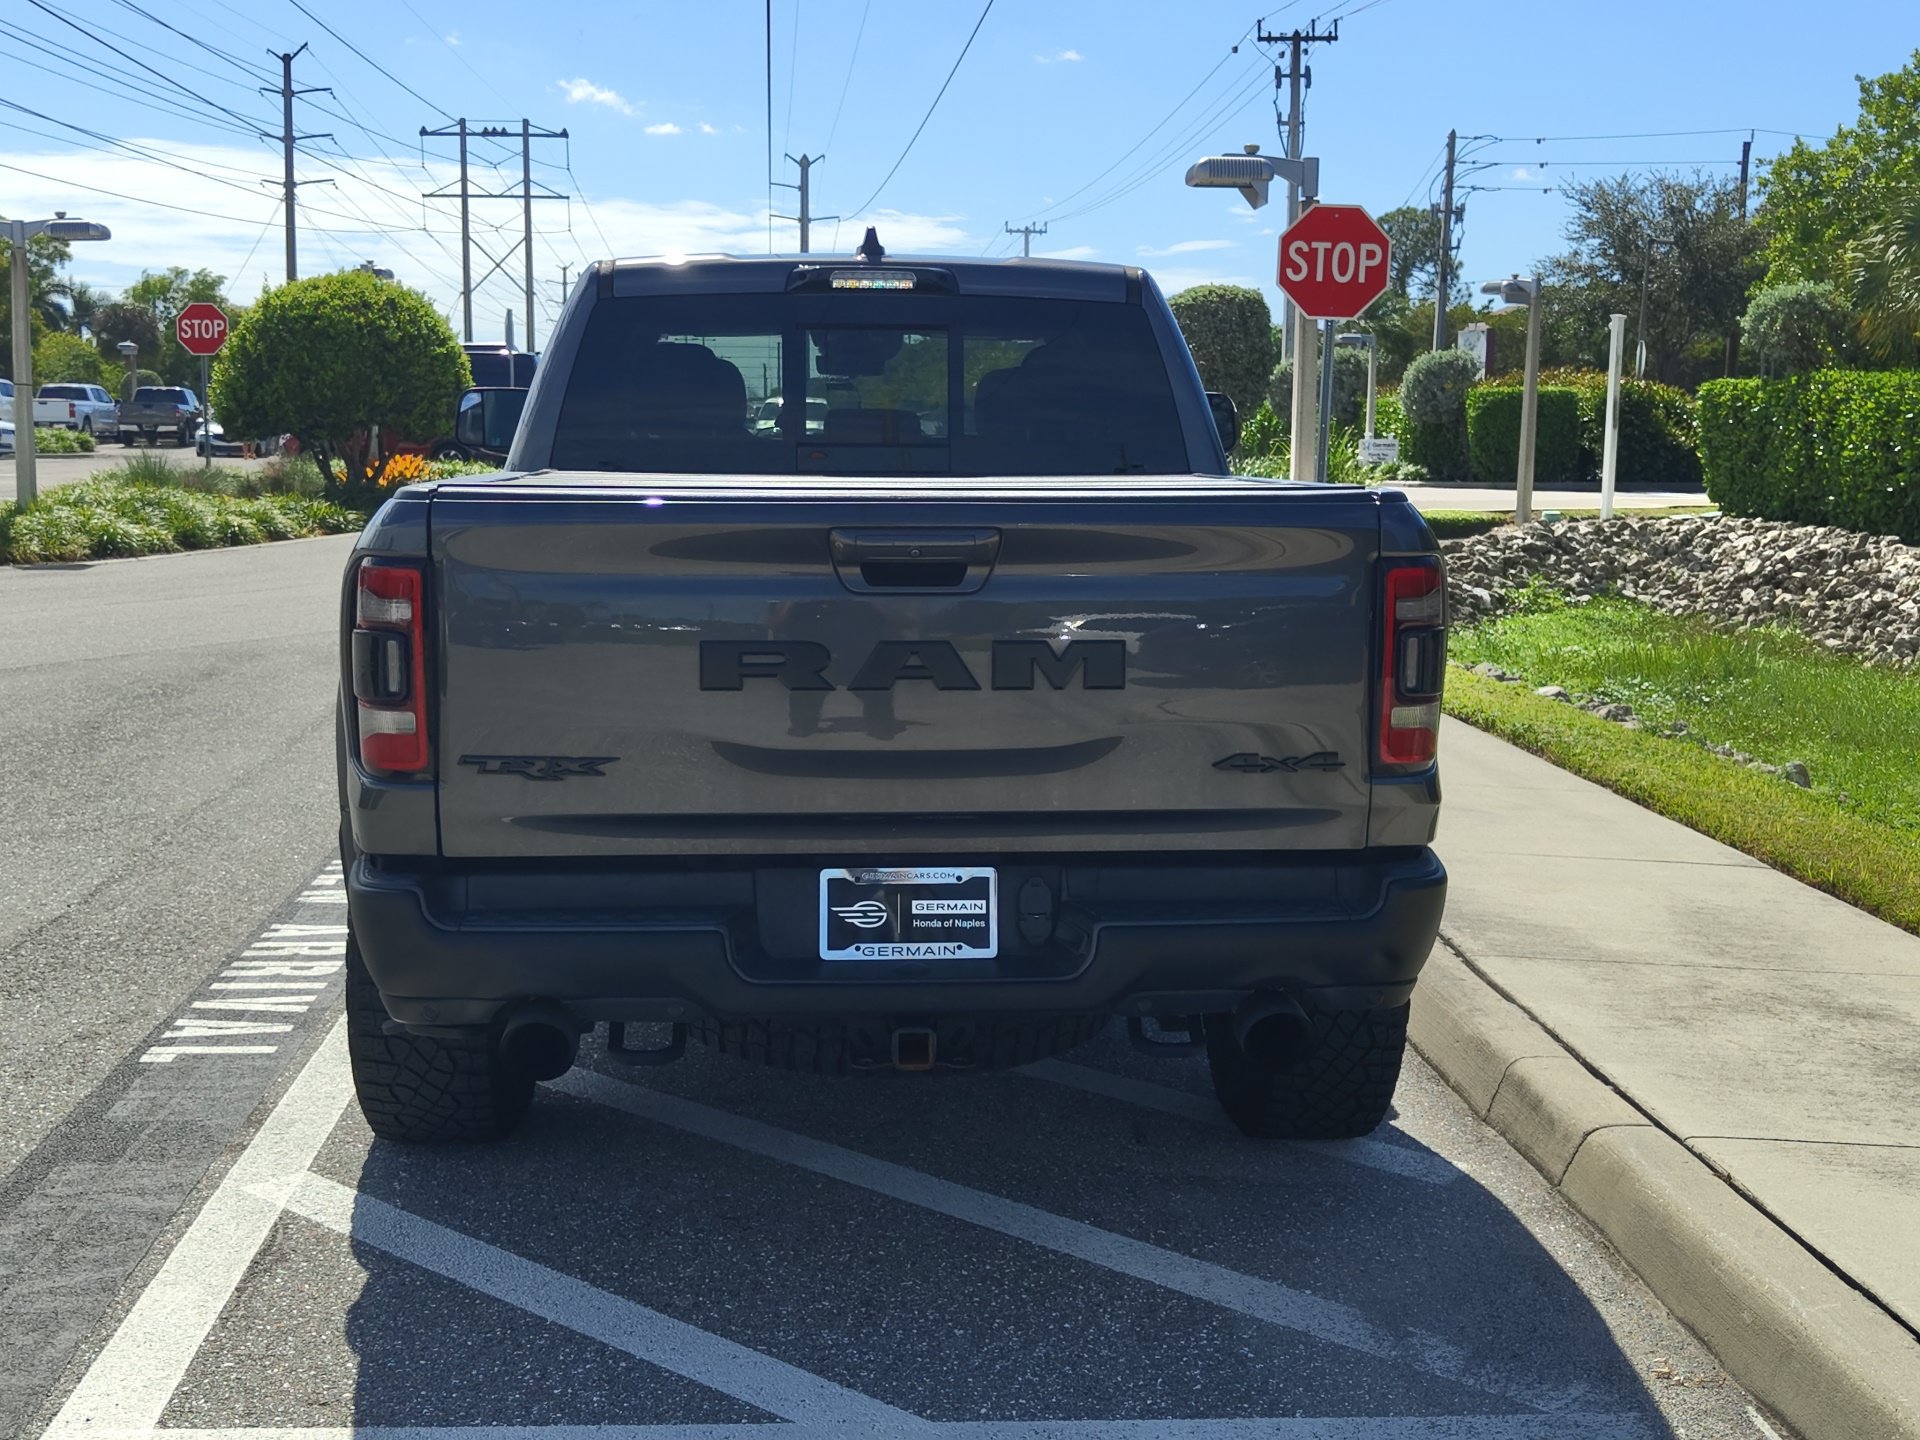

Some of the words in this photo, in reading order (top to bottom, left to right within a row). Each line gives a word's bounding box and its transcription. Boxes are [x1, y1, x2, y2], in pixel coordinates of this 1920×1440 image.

[1285, 240, 1383, 283] STOP
[181, 319, 225, 339] STOP
[700, 639, 1126, 691] RAM
[457, 754, 622, 782] TRX
[915, 903, 983, 911] GERMAIN
[913, 919, 942, 928] Honda
[943, 919, 953, 928] of
[955, 919, 986, 930] Naples
[862, 946, 956, 956] GERMAIN
